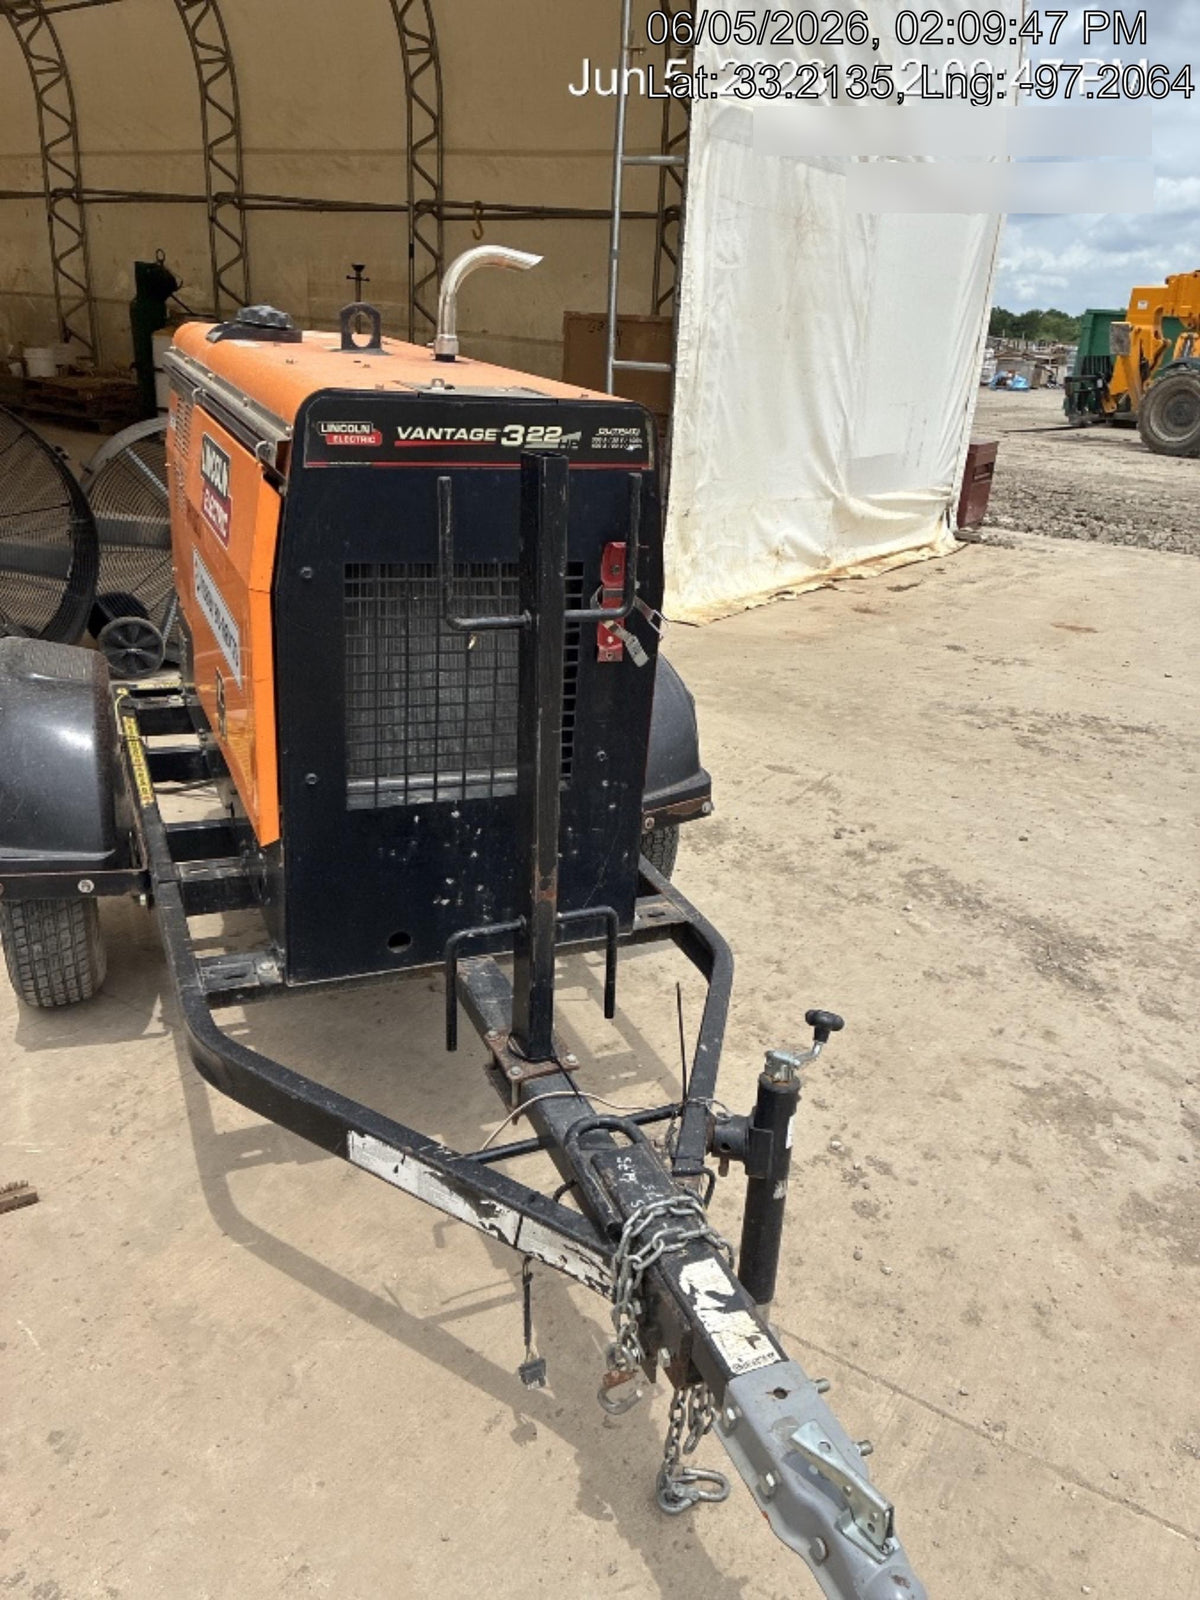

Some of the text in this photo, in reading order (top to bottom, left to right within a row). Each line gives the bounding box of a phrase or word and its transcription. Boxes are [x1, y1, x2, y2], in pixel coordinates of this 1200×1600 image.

[320, 422, 372, 435] LINCOLN
[332, 435, 377, 445] ELECTRIC
[396, 425, 499, 441] VANTAGE
[500, 424, 563, 447] 322
